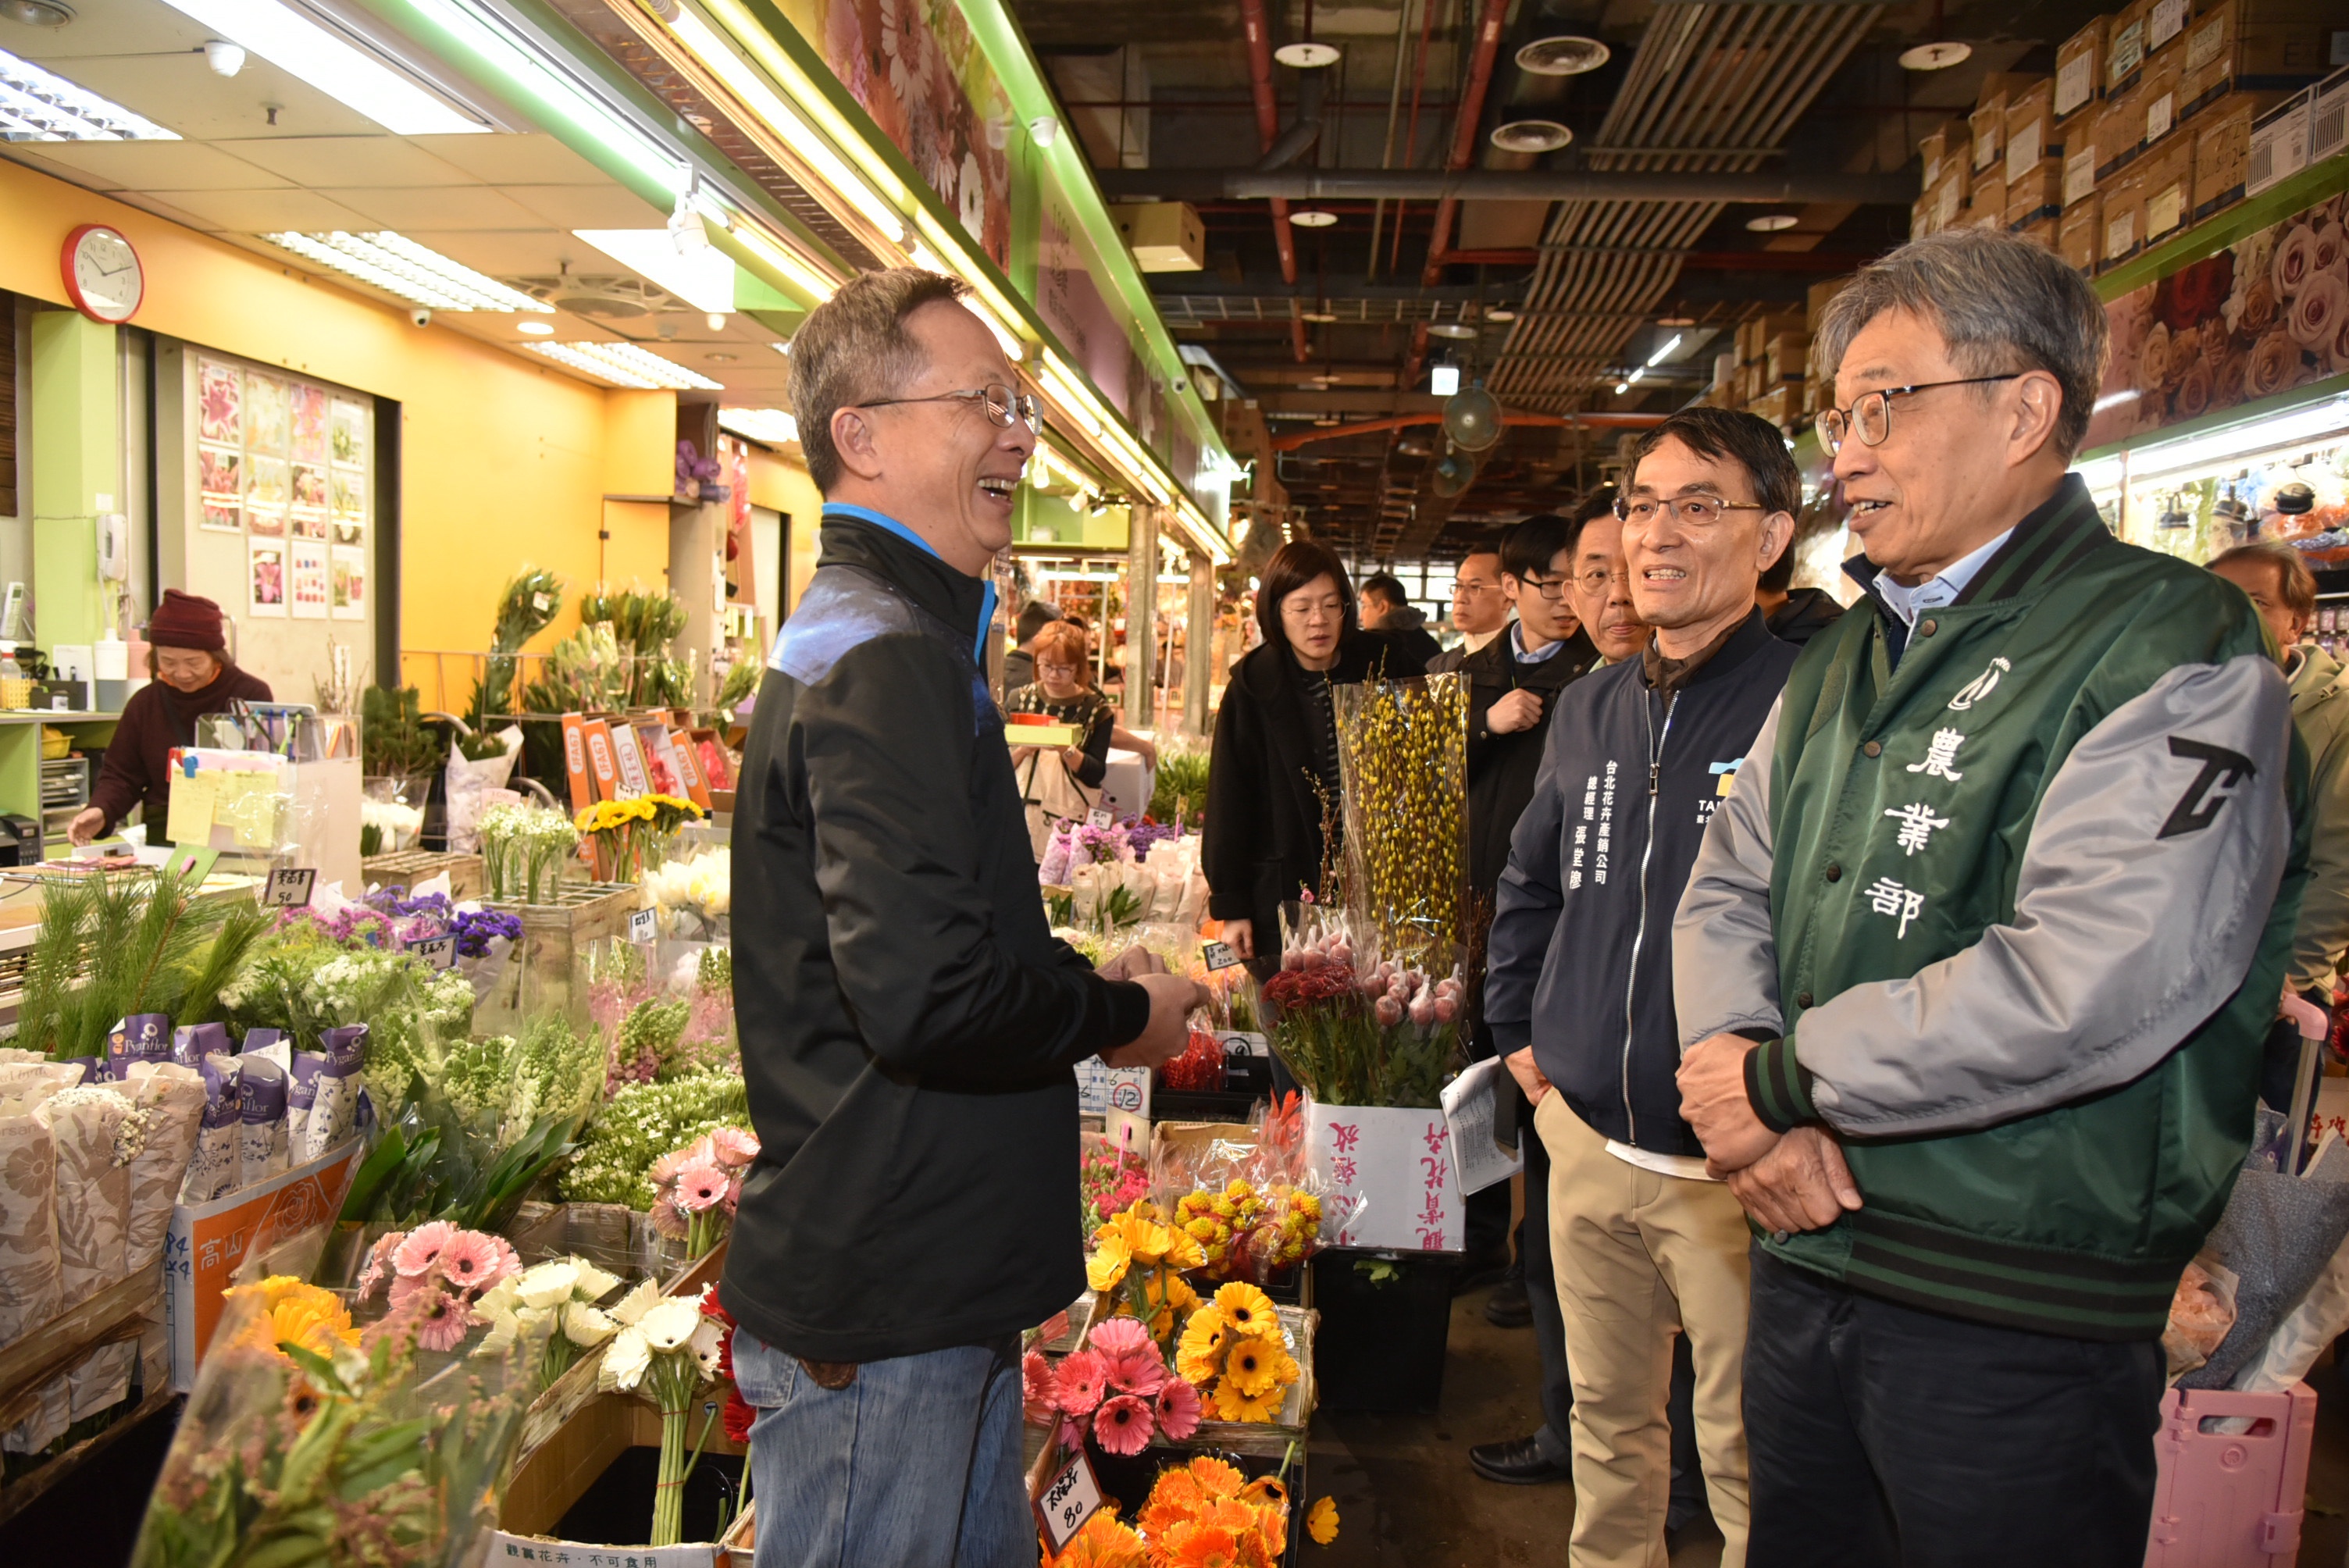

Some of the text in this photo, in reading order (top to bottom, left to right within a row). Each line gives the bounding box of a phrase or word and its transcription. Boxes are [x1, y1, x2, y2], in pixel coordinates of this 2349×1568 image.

[570, 733, 582, 770] JFA67
[593, 739, 611, 774] JFA67
[676, 750, 693, 782] JFA67
[1595, 760, 1618, 885] 台北花卉產銷公司
[1864, 726, 1965, 940] 農業部
[278, 891, 292, 904] 50
[1120, 1088, 1139, 1107] 12
[1415, 1122, 1449, 1251] 觀賞花卉
[1064, 1500, 1083, 1529] 80
